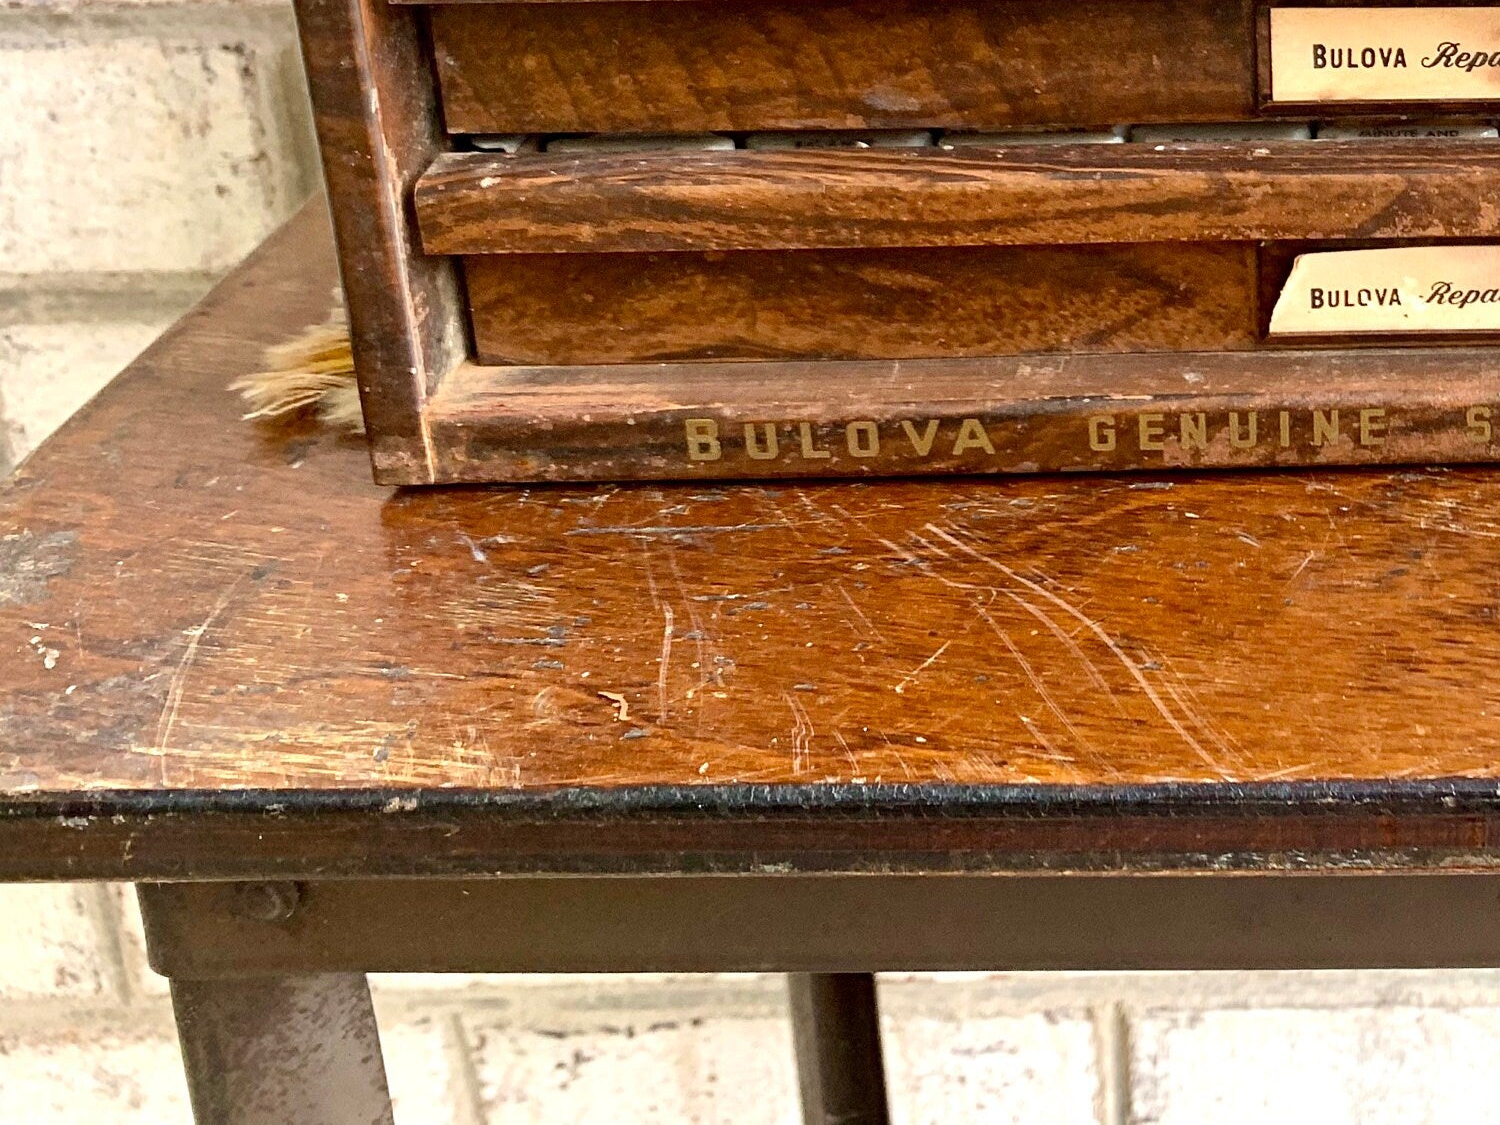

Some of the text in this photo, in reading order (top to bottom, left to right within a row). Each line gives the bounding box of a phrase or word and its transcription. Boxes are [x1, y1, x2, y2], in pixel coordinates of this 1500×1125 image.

[1312, 44, 1408, 69] BULOVA
[1310, 286, 1403, 310] BULOVA
[685, 418, 996, 462] BULOVA
[1088, 407, 1388, 452] GENUINE
